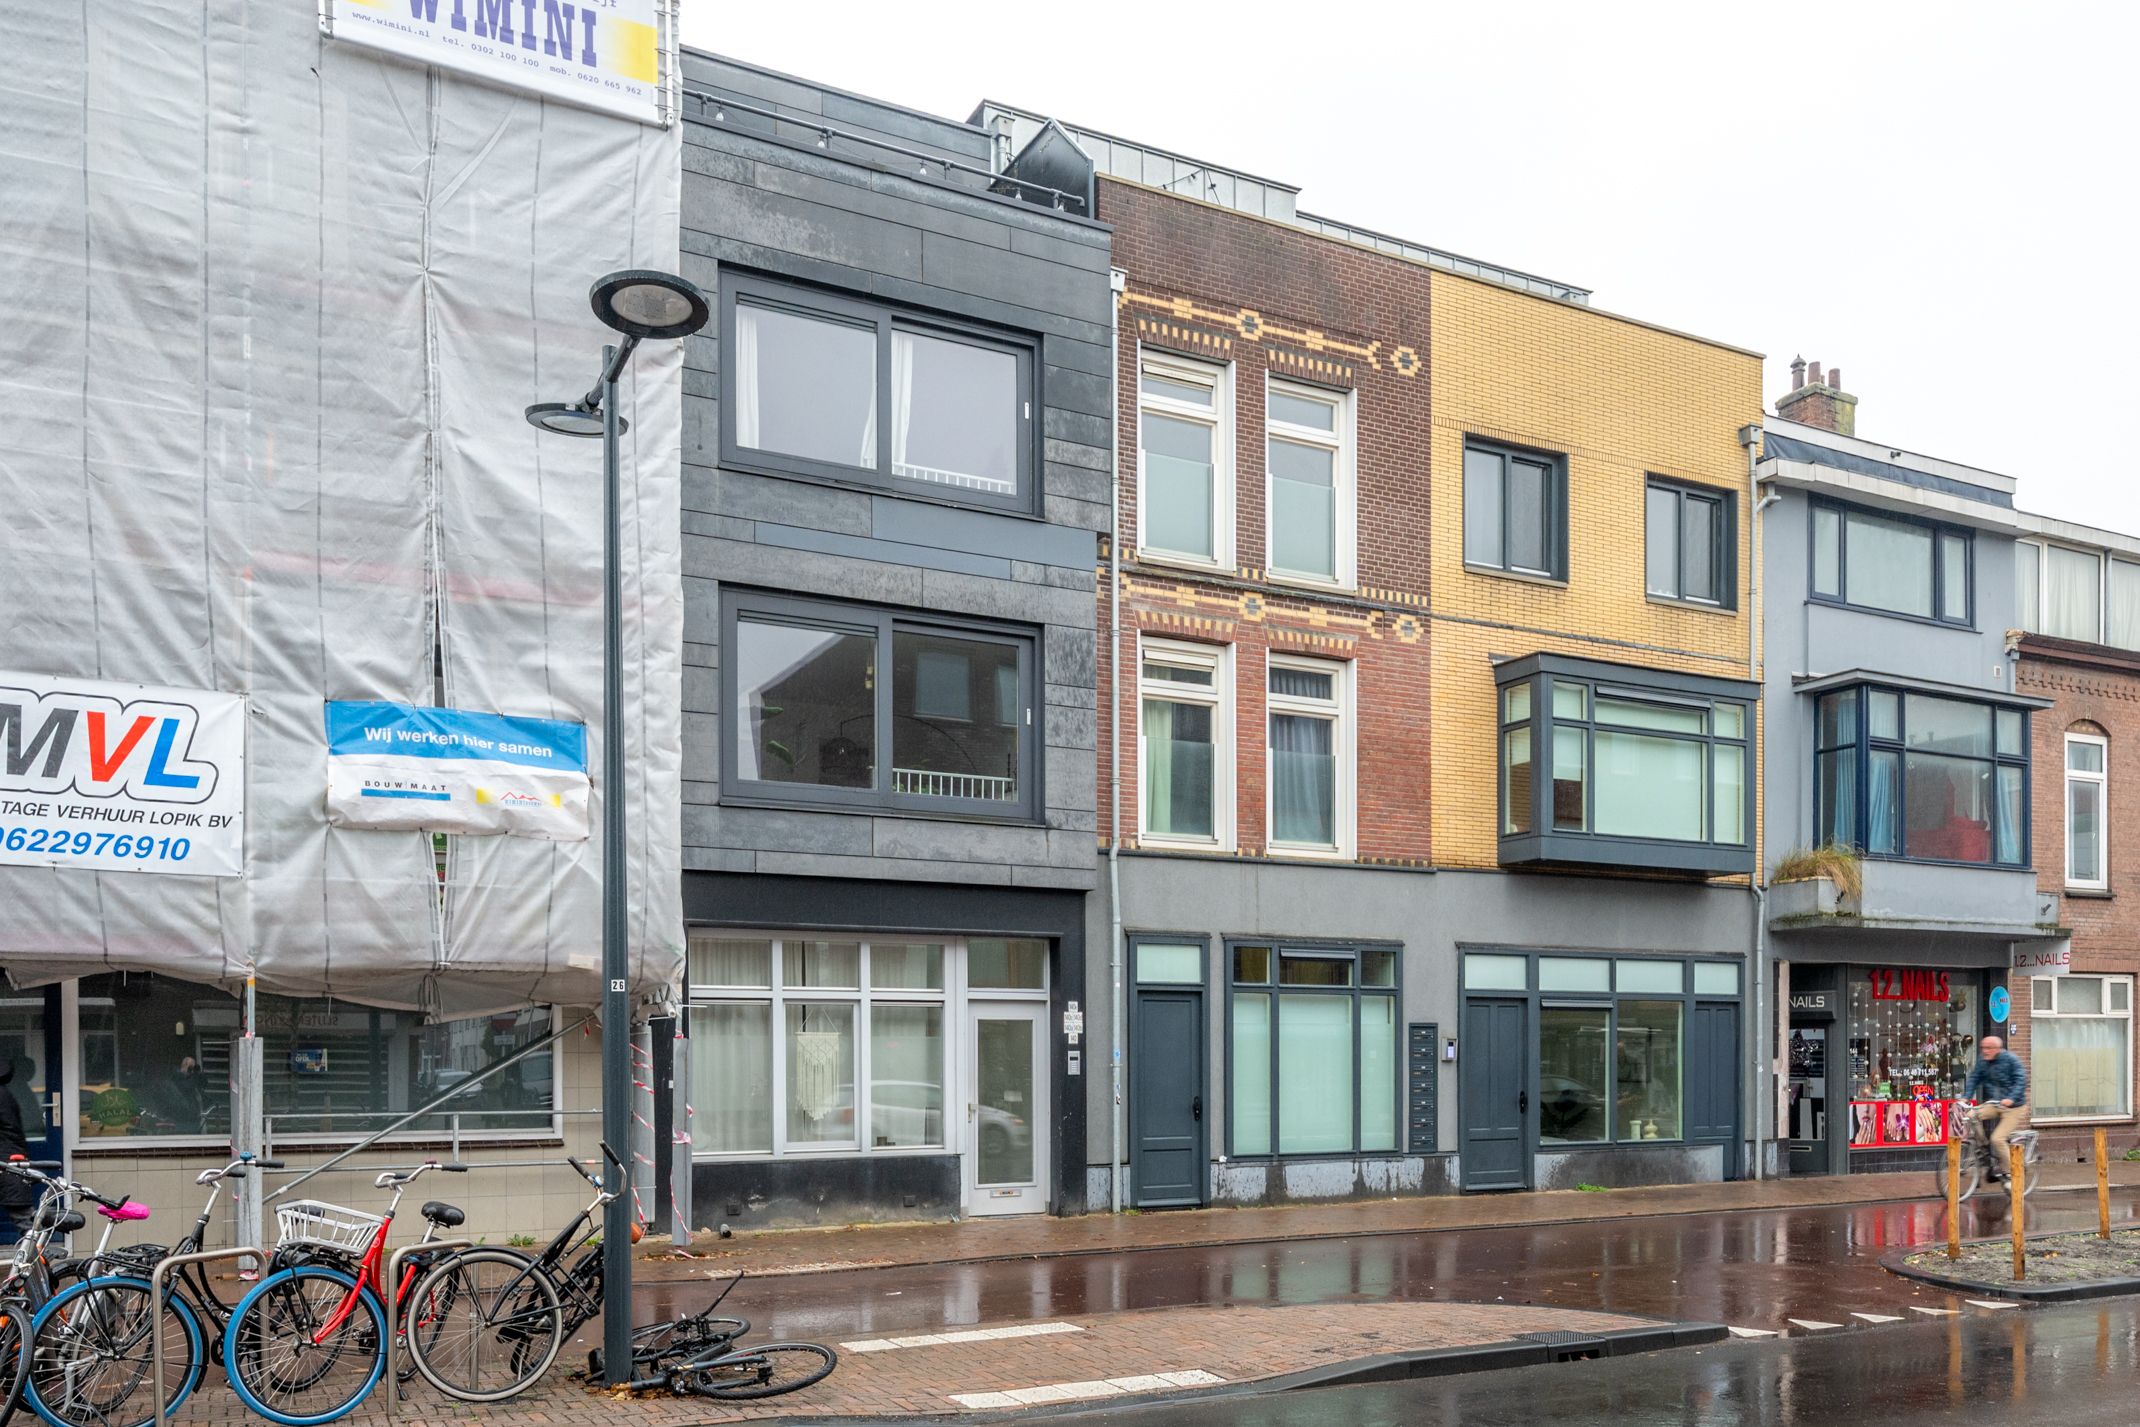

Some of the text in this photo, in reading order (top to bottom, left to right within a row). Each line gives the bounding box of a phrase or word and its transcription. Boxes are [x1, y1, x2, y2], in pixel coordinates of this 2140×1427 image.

[352, 12, 430, 38] www.wimini.nl
[443, 36, 465, 47] tel.
[471, 44, 494, 55] 0302
[500, 51, 517, 62] 100
[523, 58, 540, 68] 100
[549, 65, 572, 77] mob.
[577, 72, 600, 85] 0620
[625, 86, 642, 96] 962
[364, 727, 552, 758] Wij werken hier samen
[57, 805, 145, 824] VERHUUR
[150, 811, 203, 827] LOPIK
[208, 814, 233, 829] BV
[612, 980, 624, 990] 26
[1789, 995, 1825, 1008] NAILS
